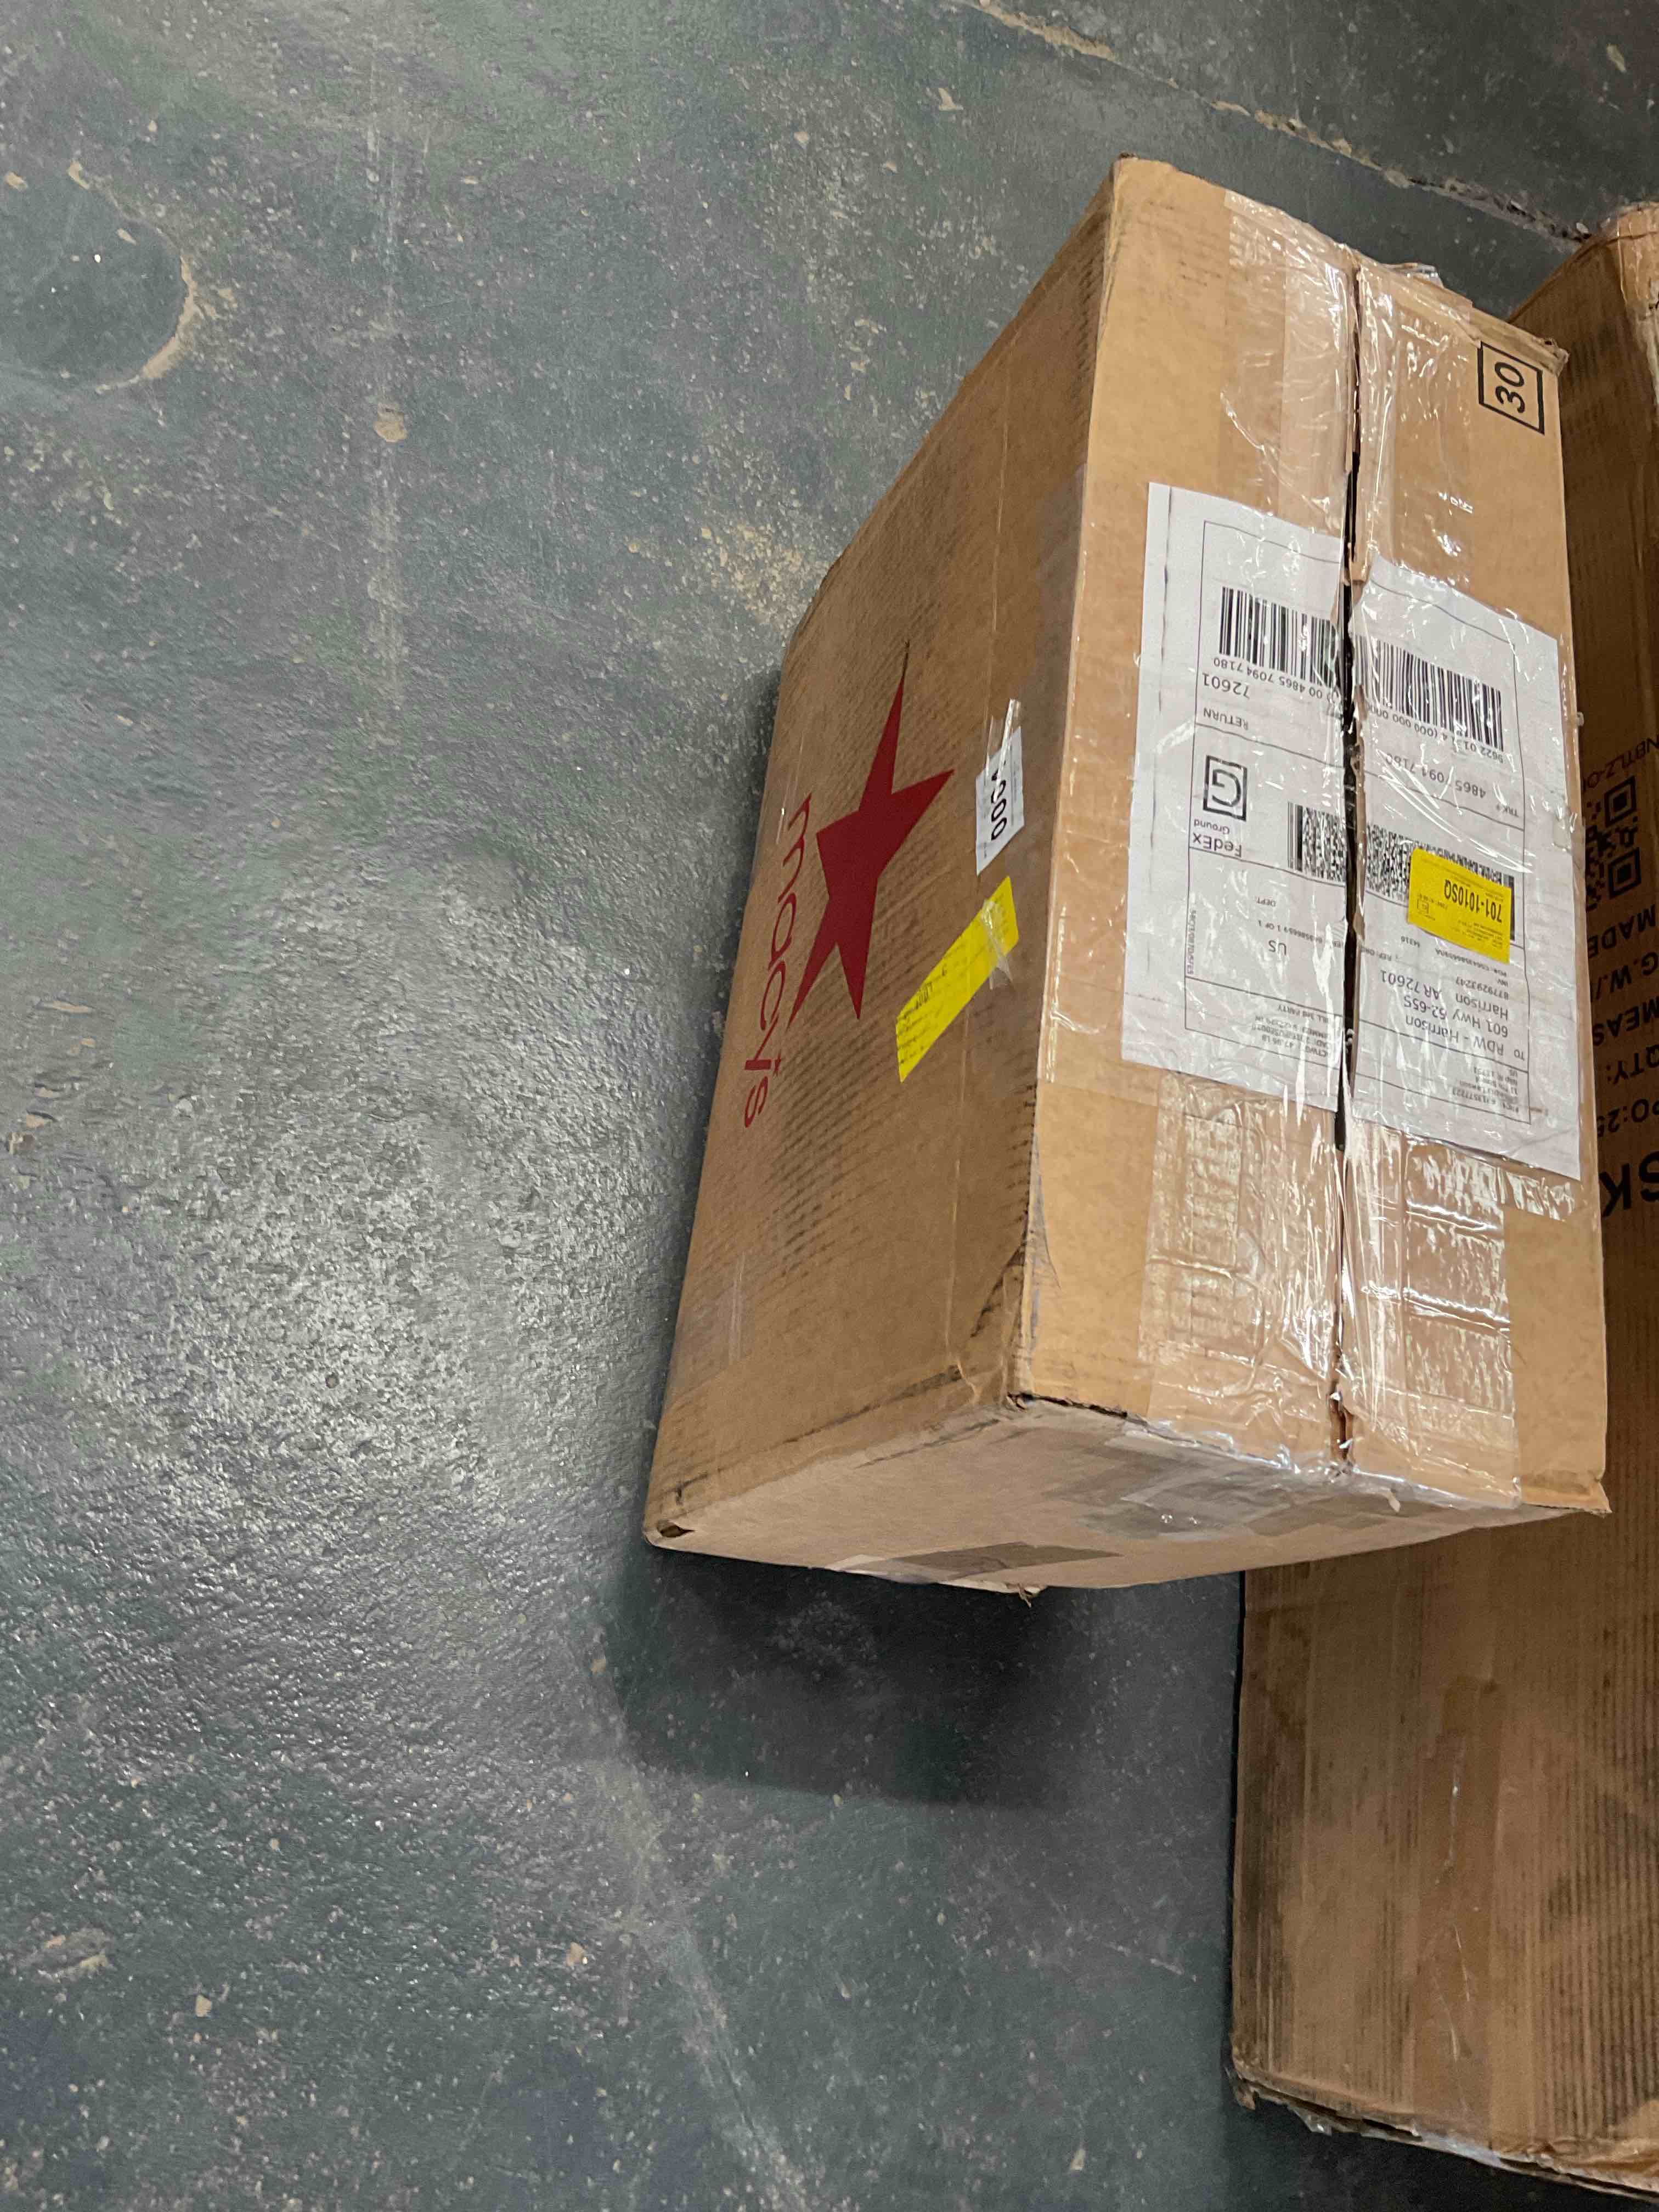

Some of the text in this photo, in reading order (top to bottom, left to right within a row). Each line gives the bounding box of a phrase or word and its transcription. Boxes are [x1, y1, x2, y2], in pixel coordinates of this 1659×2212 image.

[1494, 362, 1525, 414] 30
[1213, 657, 1244, 673] 7180
[1246, 667, 1274, 683] 7094
[1202, 673, 1250, 700] 72601
[1278, 676, 1306, 693] 4865
[1203, 708, 1248, 731] RETURN
[1392, 714, 1411, 729] 000
[1212, 769, 1242, 807] G
[1454, 780, 1487, 799] 4865
[1193, 819, 1229, 834] Ground
[1193, 832, 1242, 858] FedEx
[1443, 879, 1502, 924] 701-1010SQ
[1587, 904, 1656, 958] MADE
[1268, 940, 1287, 956] US
[1380, 969, 1508, 1021] Harrison AR 72601
[1406, 1015, 1458, 1043] Harrison
[1452, 1009, 1480, 1029] Hwy
[1486, 1019, 1508, 1038] 601
[1474, 1036, 1503, 1056] RDW
[1514, 1049, 1525, 1061] TO
